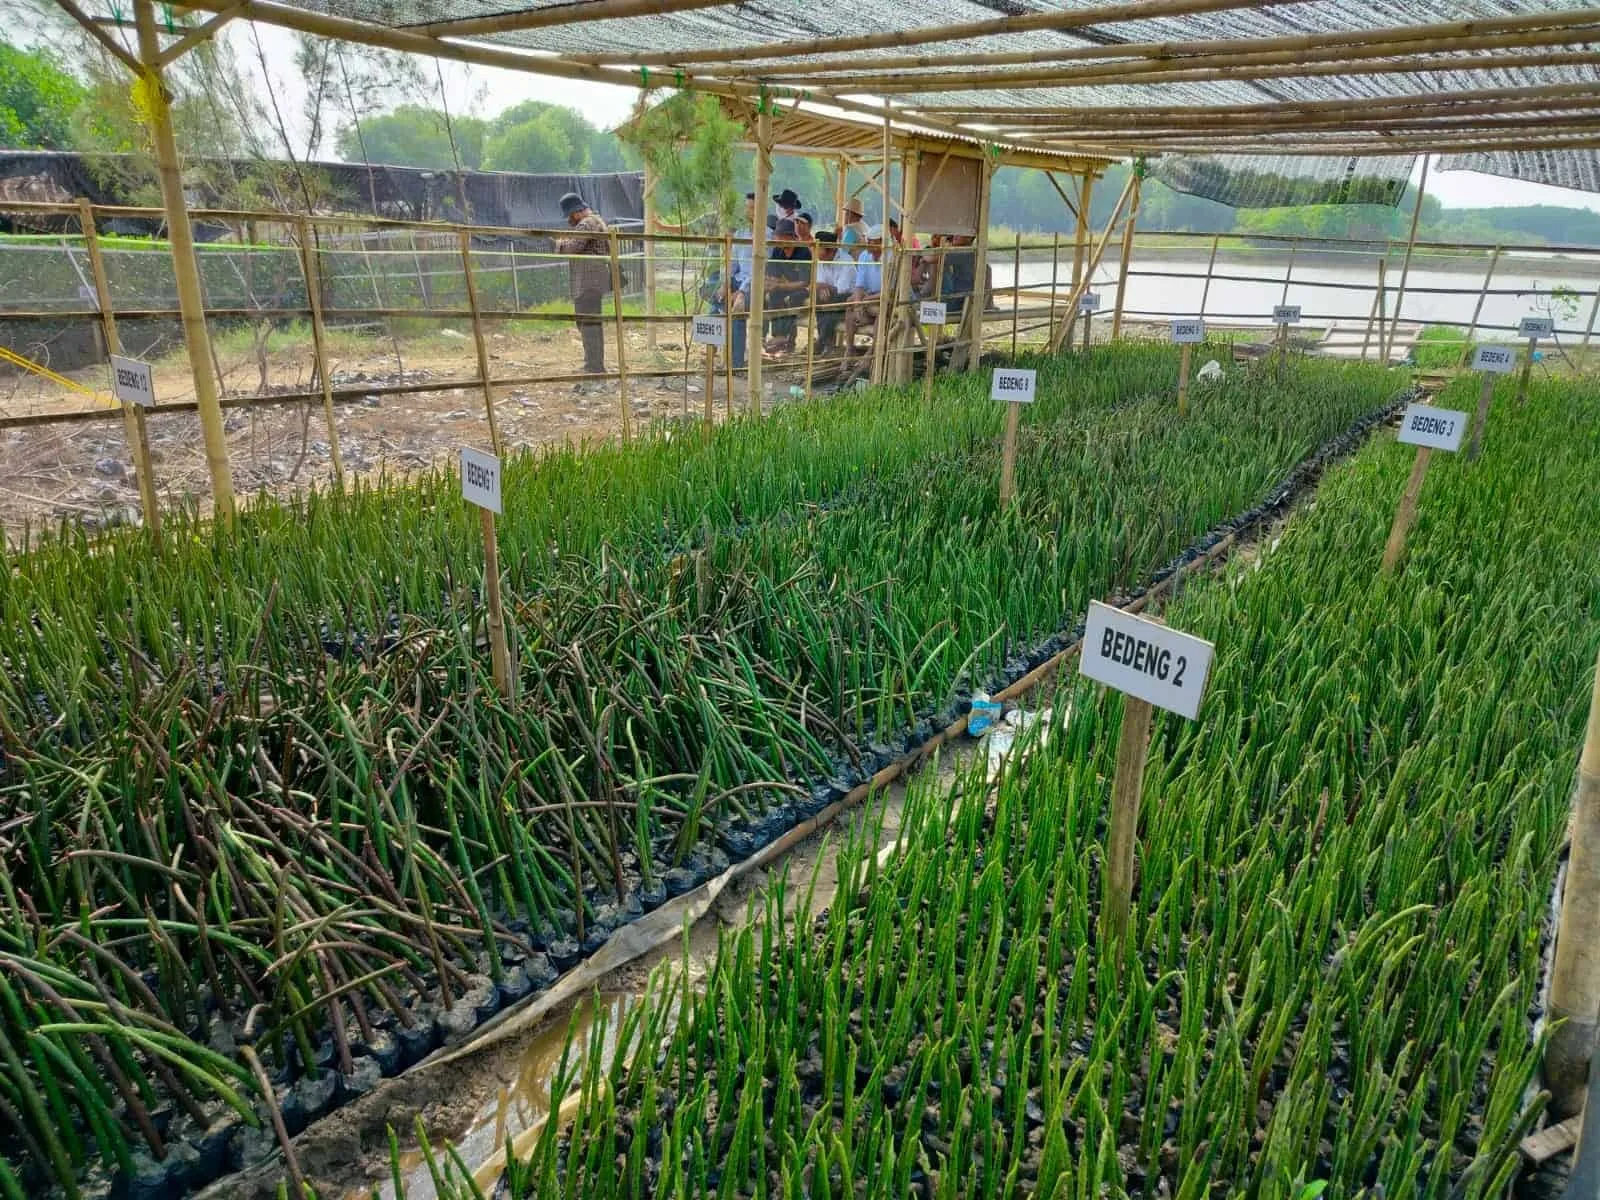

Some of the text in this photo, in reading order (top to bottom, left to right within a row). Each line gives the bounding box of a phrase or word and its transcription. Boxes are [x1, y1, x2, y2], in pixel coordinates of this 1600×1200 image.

[696, 323, 715, 336] BEDENG
[1480, 351, 1505, 363] BEDENG
[117, 368, 140, 390] BEDENG
[999, 376, 1023, 391] BEDENG
[1411, 415, 1455, 437] BEDENG 3
[467, 461, 490, 491] BEDENG
[1101, 627, 1187, 688] BEDENG 2
